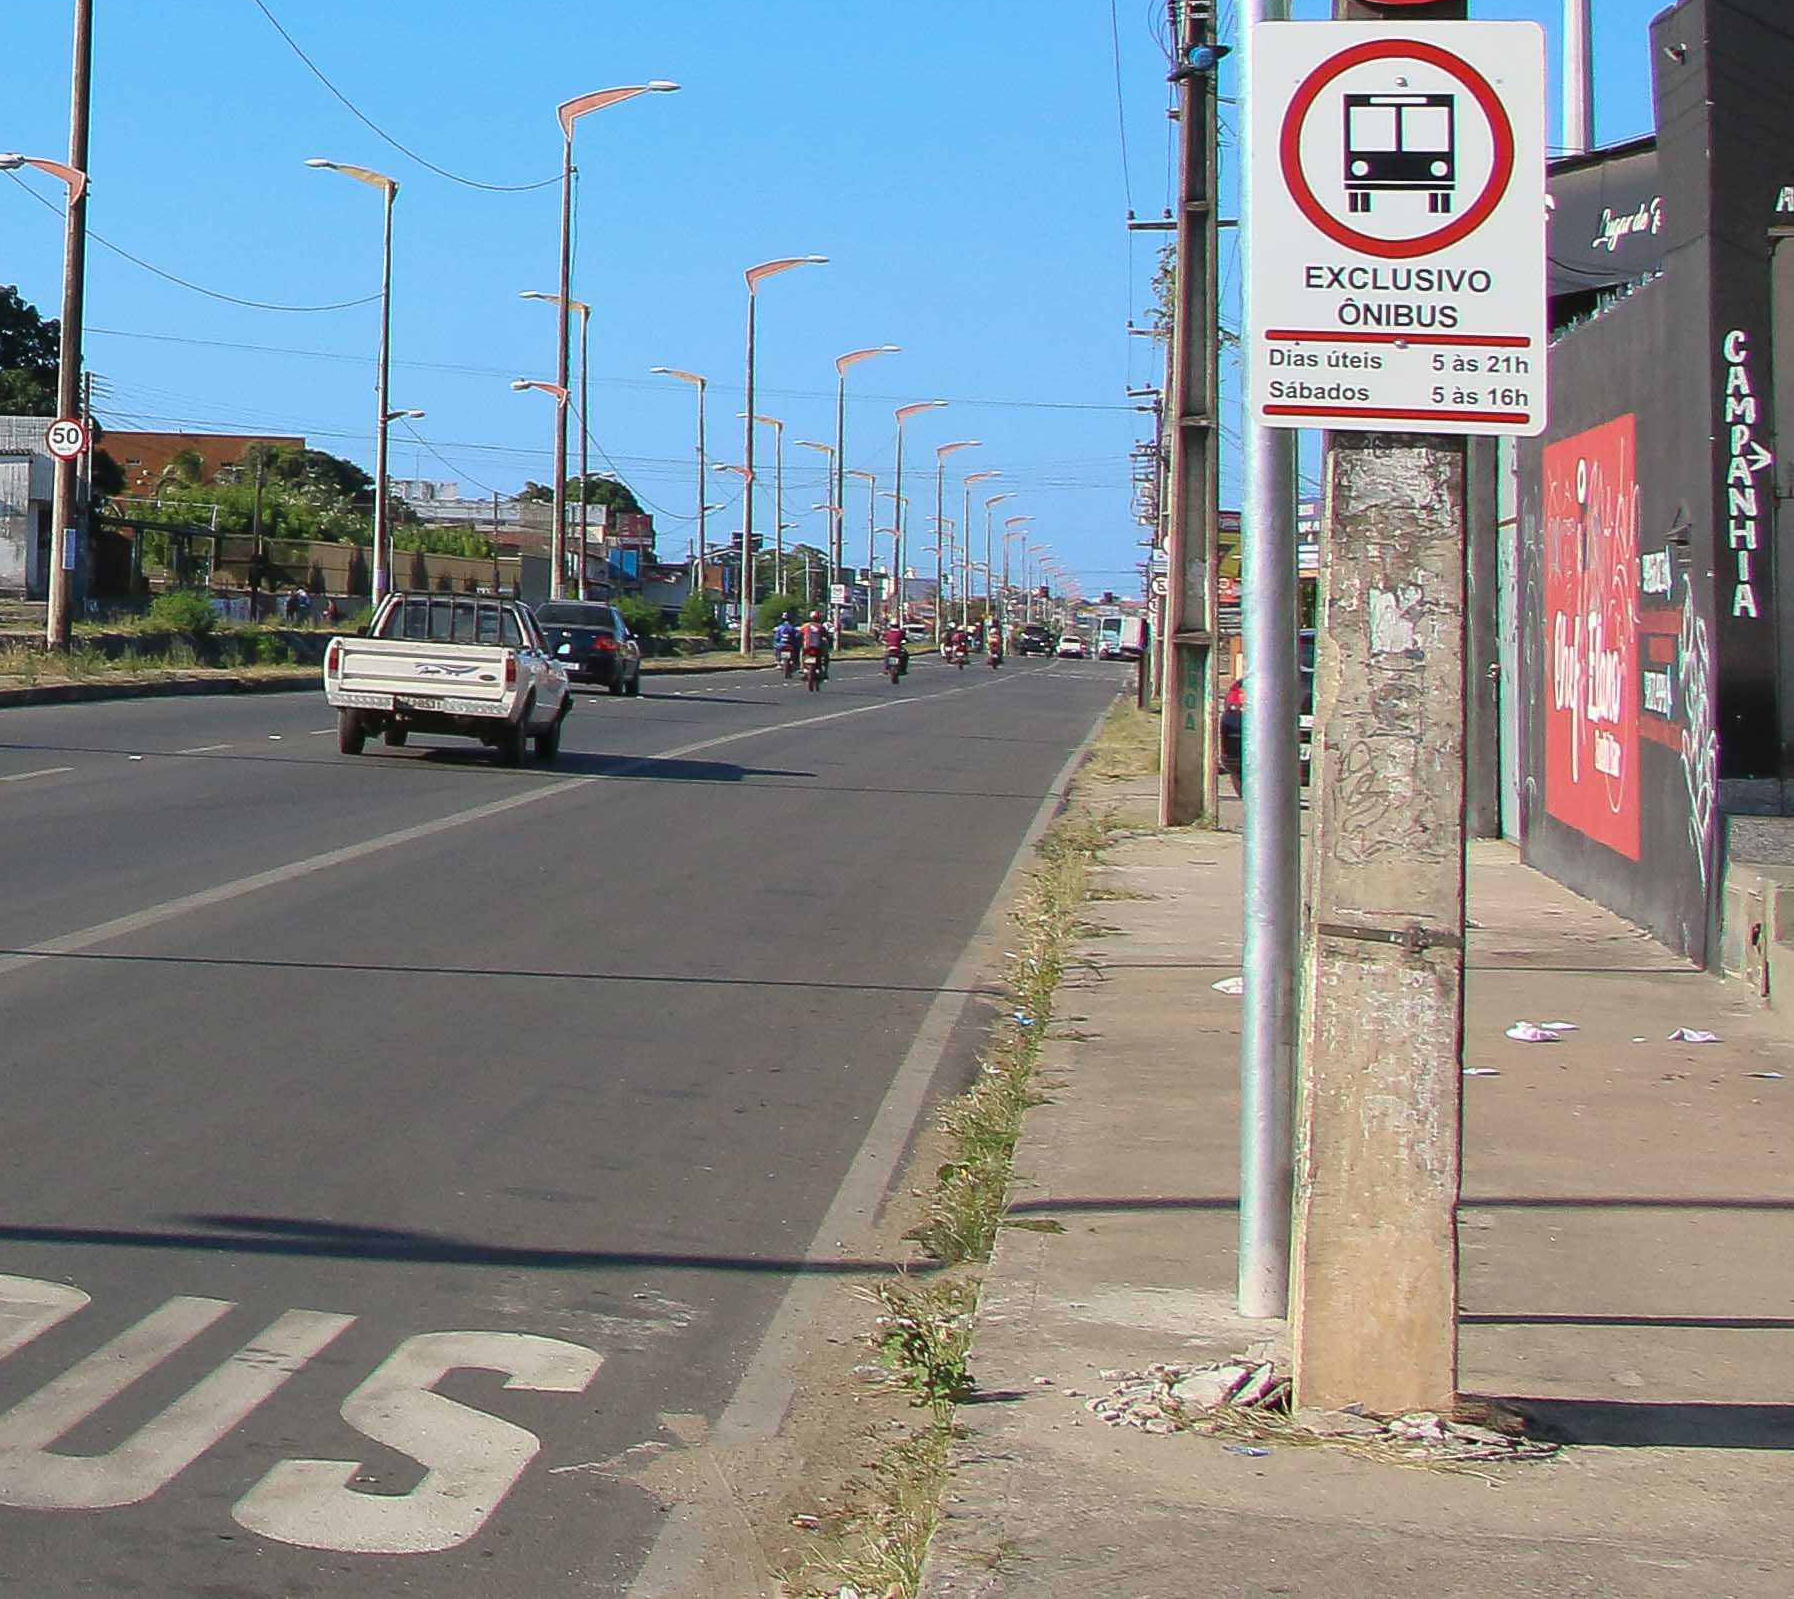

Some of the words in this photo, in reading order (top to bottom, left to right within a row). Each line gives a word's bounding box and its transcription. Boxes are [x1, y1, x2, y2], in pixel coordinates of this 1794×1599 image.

[1304, 264, 1492, 294] EXCLUSIVO
[1337, 298, 1459, 330] ÔNIBUS
[1268, 348, 1320, 370] Dias
[1326, 348, 1383, 371] úteis
[1431, 353, 1445, 374] 5
[1451, 353, 1480, 374] às
[1485, 354, 1530, 376] 21h
[1268, 378, 1370, 402] Sábados
[1431, 385, 1445, 406] 5
[1451, 384, 1480, 406] às
[1486, 386, 1530, 407] 16h
[52, 427, 80, 445] 50
